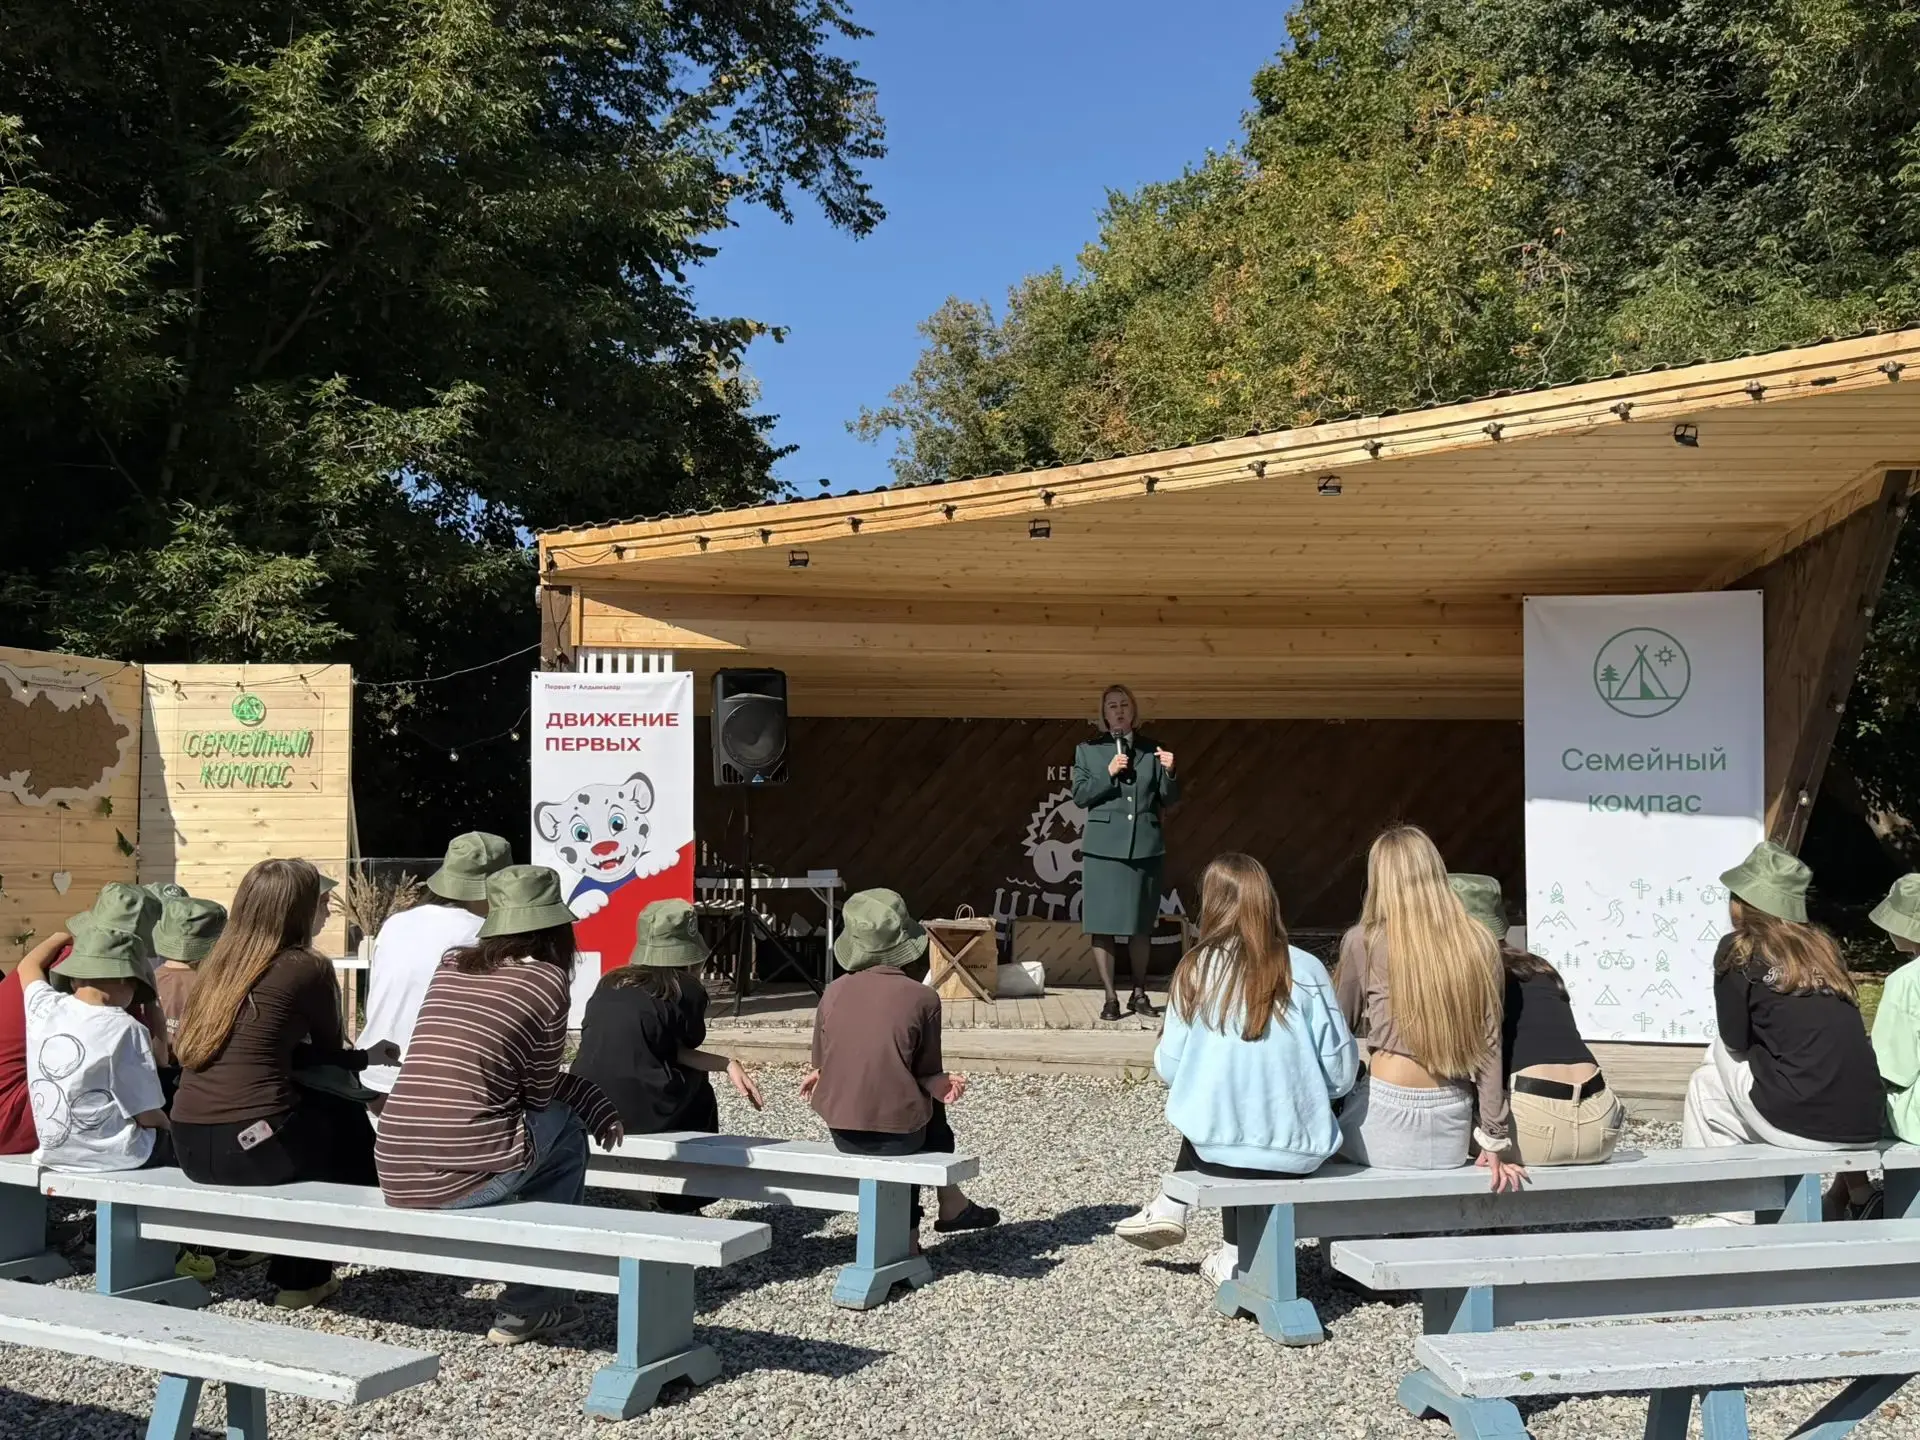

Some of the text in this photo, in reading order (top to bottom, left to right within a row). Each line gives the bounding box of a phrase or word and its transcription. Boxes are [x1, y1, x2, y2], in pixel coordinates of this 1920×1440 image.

[546, 712, 679, 729] ДВИЖЕНИЕ
[545, 737, 642, 752] ПЕРВЫХ
[1562, 746, 1727, 772] Семейный
[1588, 794, 1702, 813] компас
